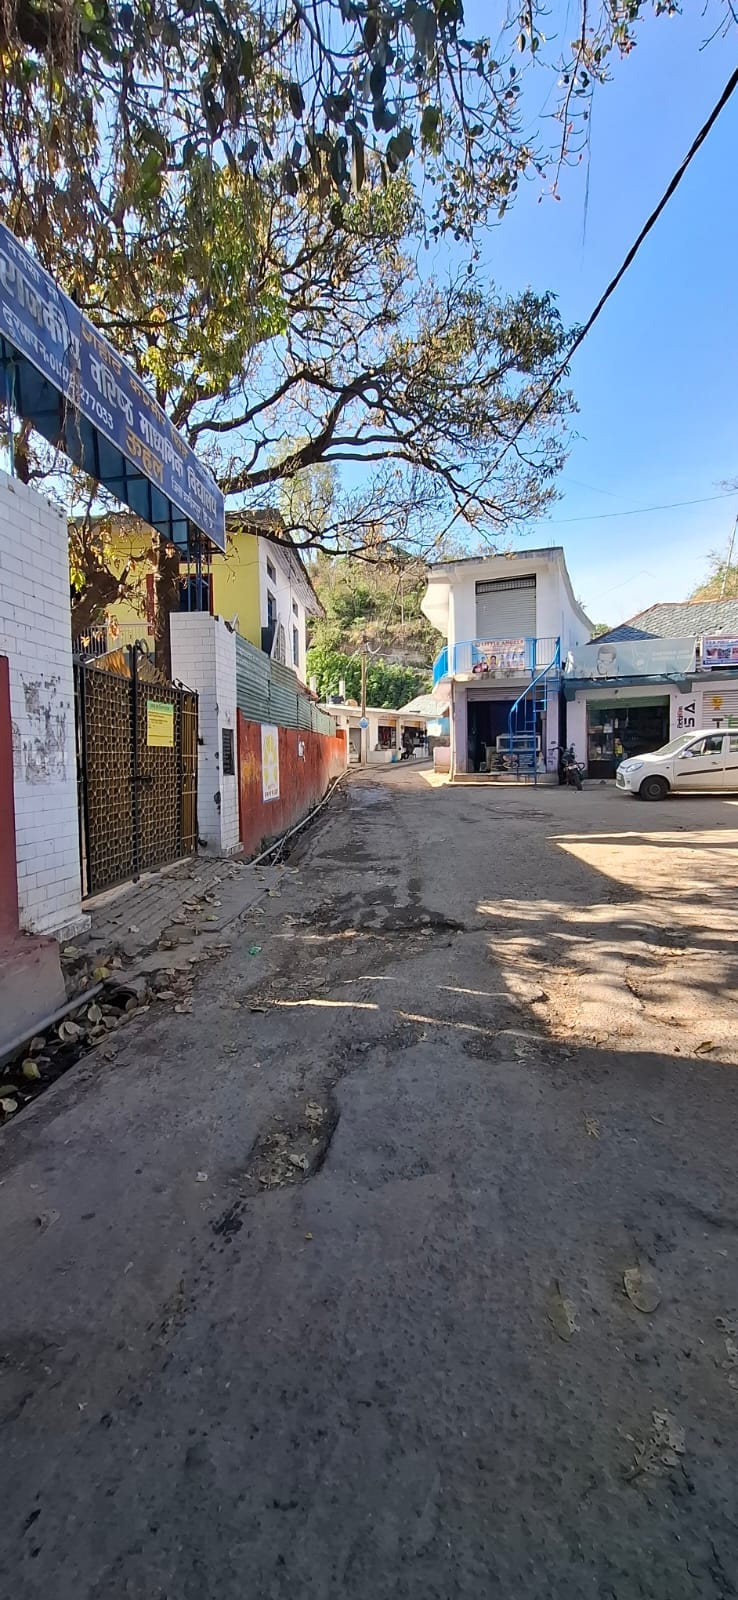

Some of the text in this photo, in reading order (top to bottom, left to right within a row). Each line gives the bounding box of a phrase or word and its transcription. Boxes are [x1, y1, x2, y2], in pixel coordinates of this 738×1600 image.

[89, 353, 134, 426] वरिष्ठ
[139, 411, 184, 477] माध्यमिक
[186, 464, 217, 518] विद्यालय
